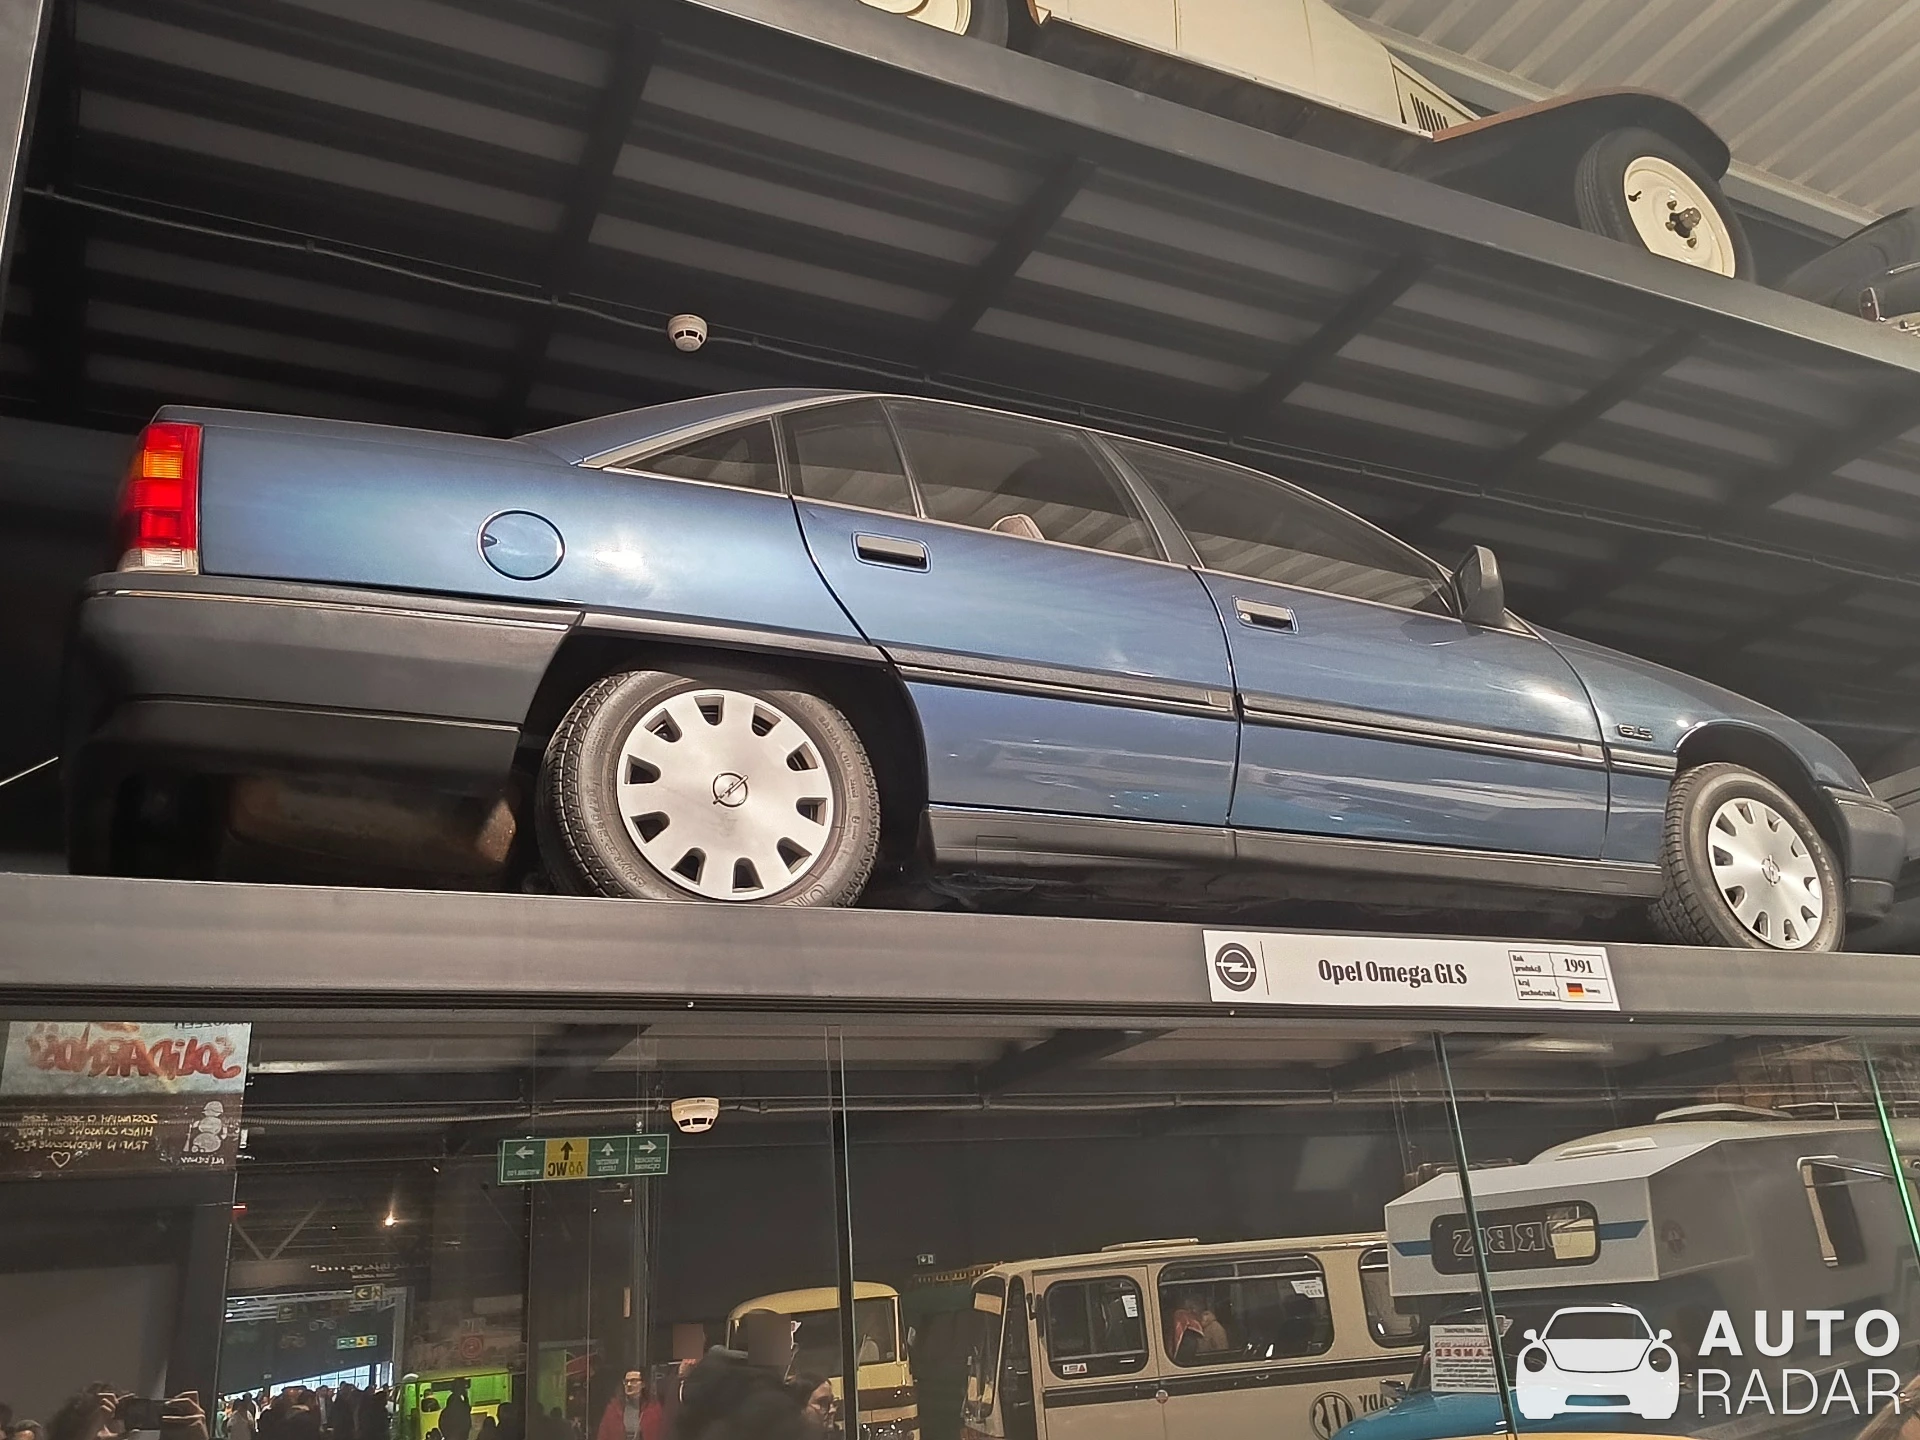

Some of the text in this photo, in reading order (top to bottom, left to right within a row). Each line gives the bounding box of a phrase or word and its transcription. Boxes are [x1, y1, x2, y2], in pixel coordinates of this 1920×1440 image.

[1318, 959, 1468, 988] Opel Omega GLS
[1563, 958, 1595, 974] 1991
